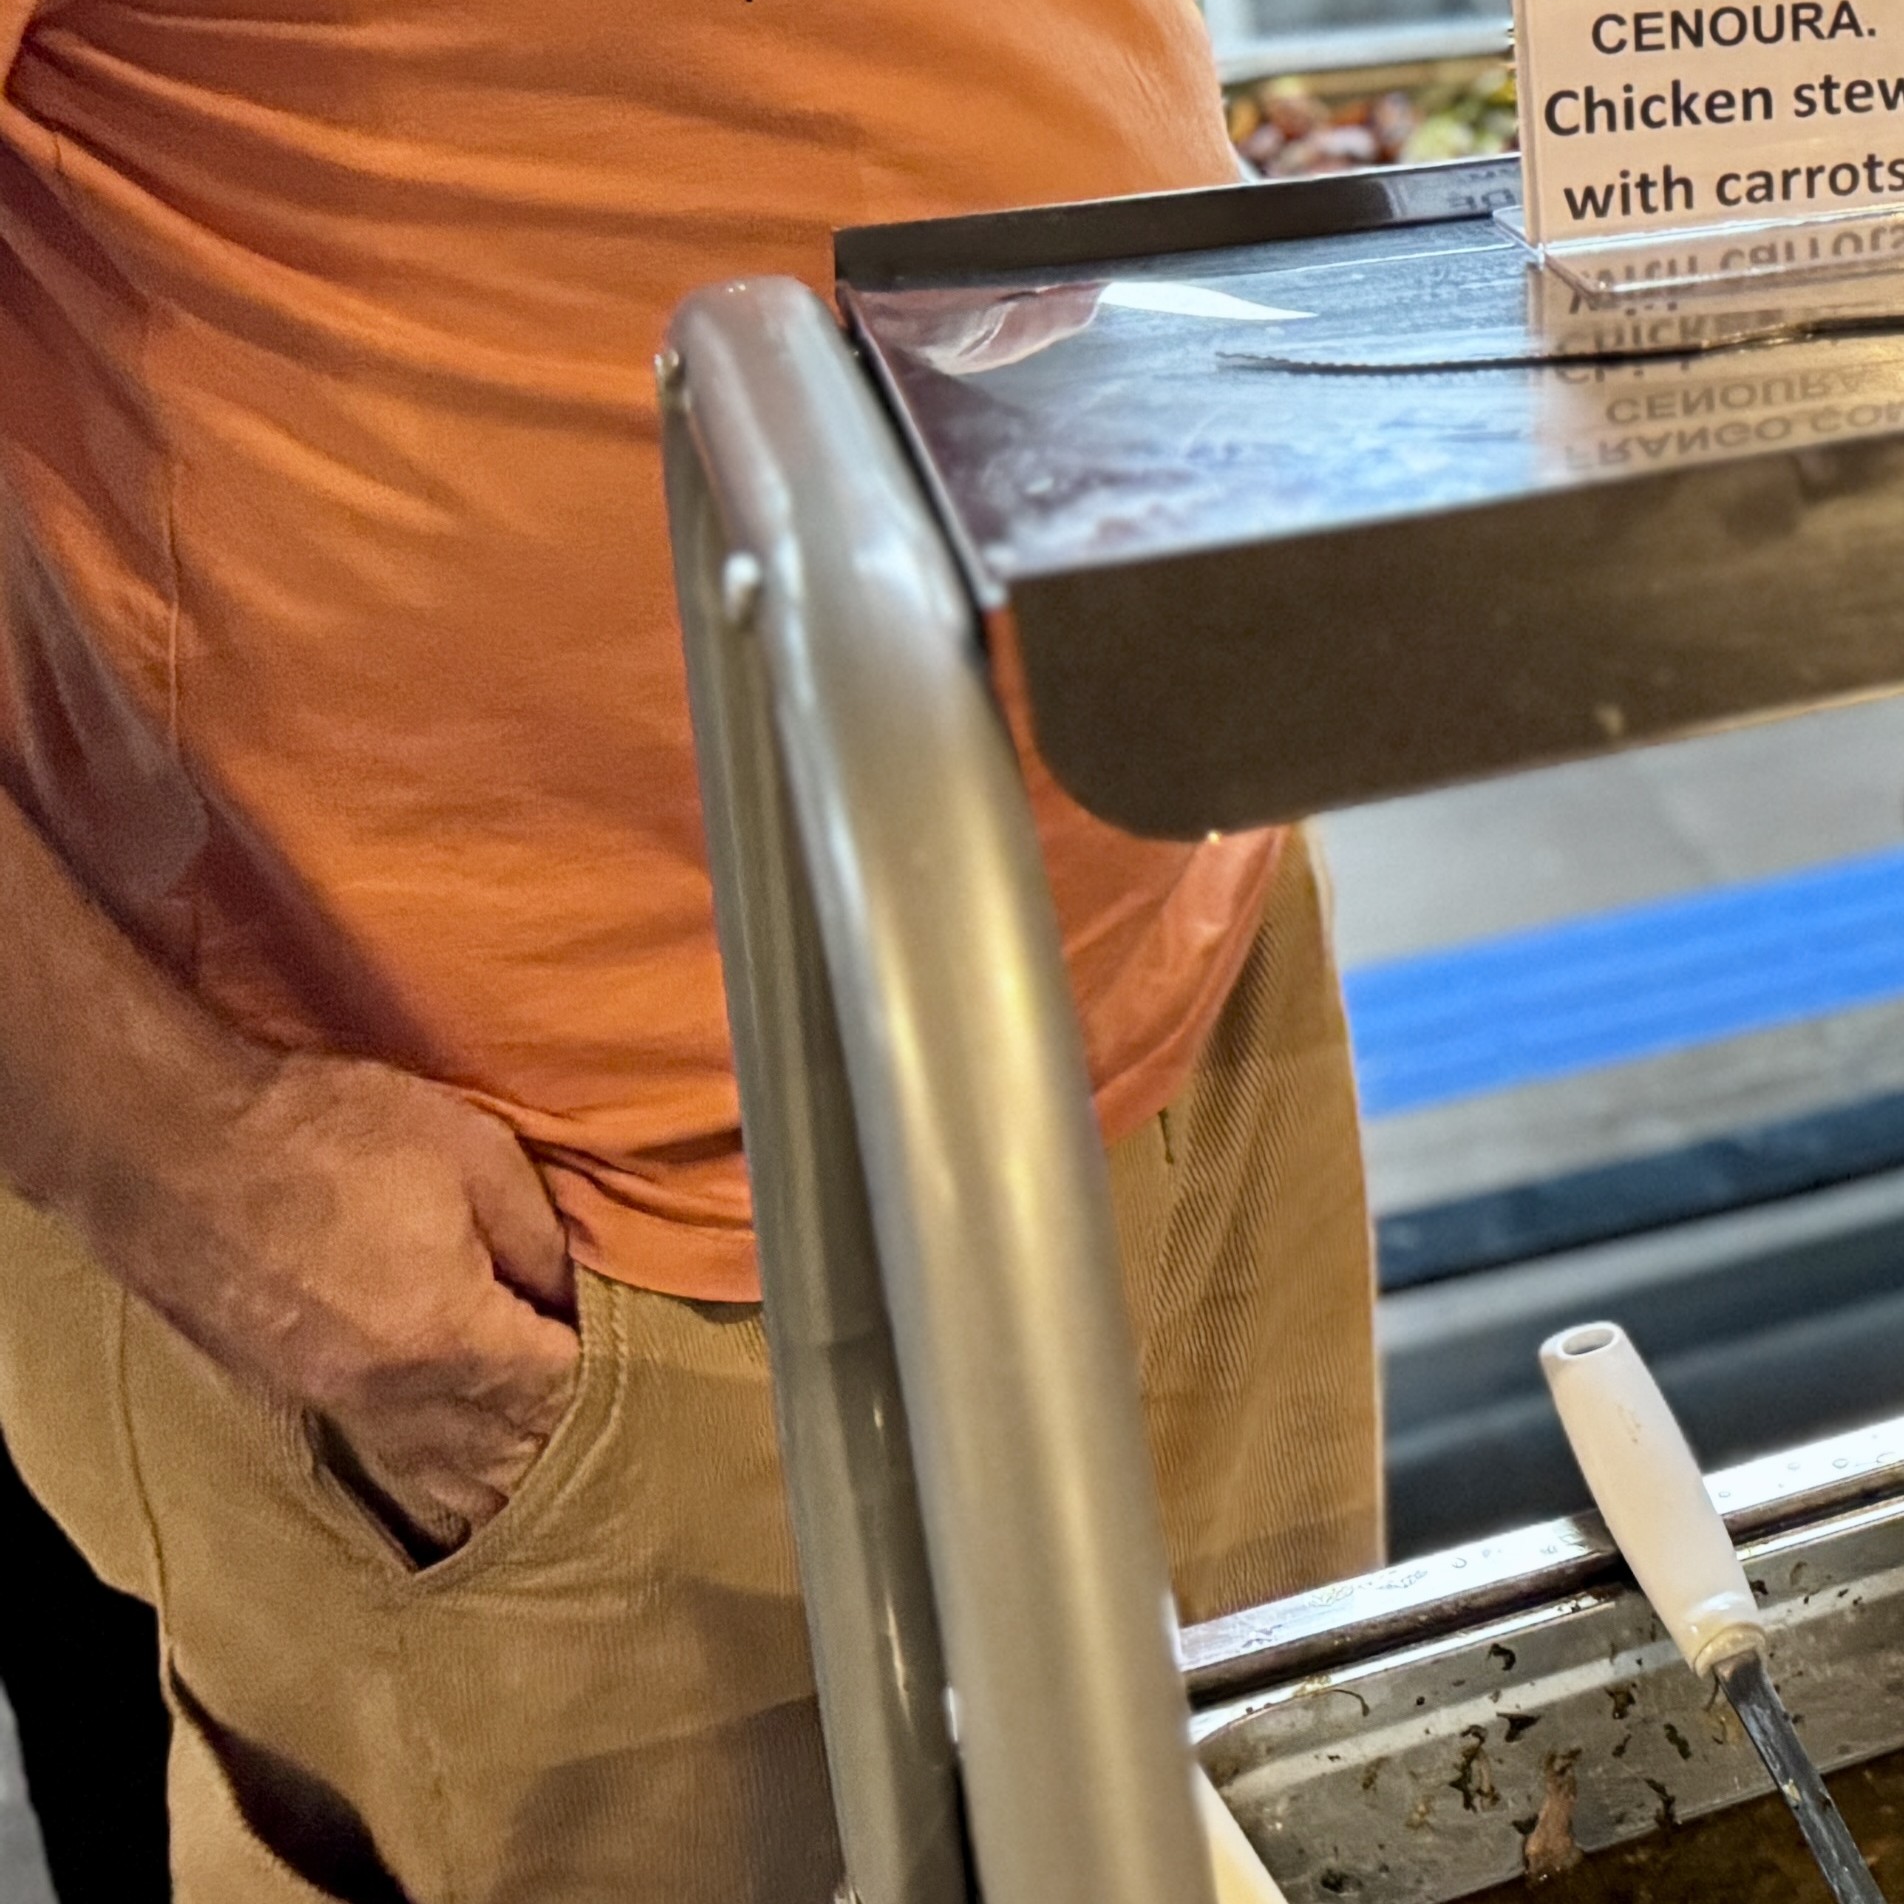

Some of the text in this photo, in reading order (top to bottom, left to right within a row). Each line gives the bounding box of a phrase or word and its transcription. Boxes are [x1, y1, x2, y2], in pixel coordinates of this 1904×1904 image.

[1592, 0, 1875, 54] CENOURA.
[1545, 79, 1772, 136] Chicken
[1564, 165, 1693, 220] with
